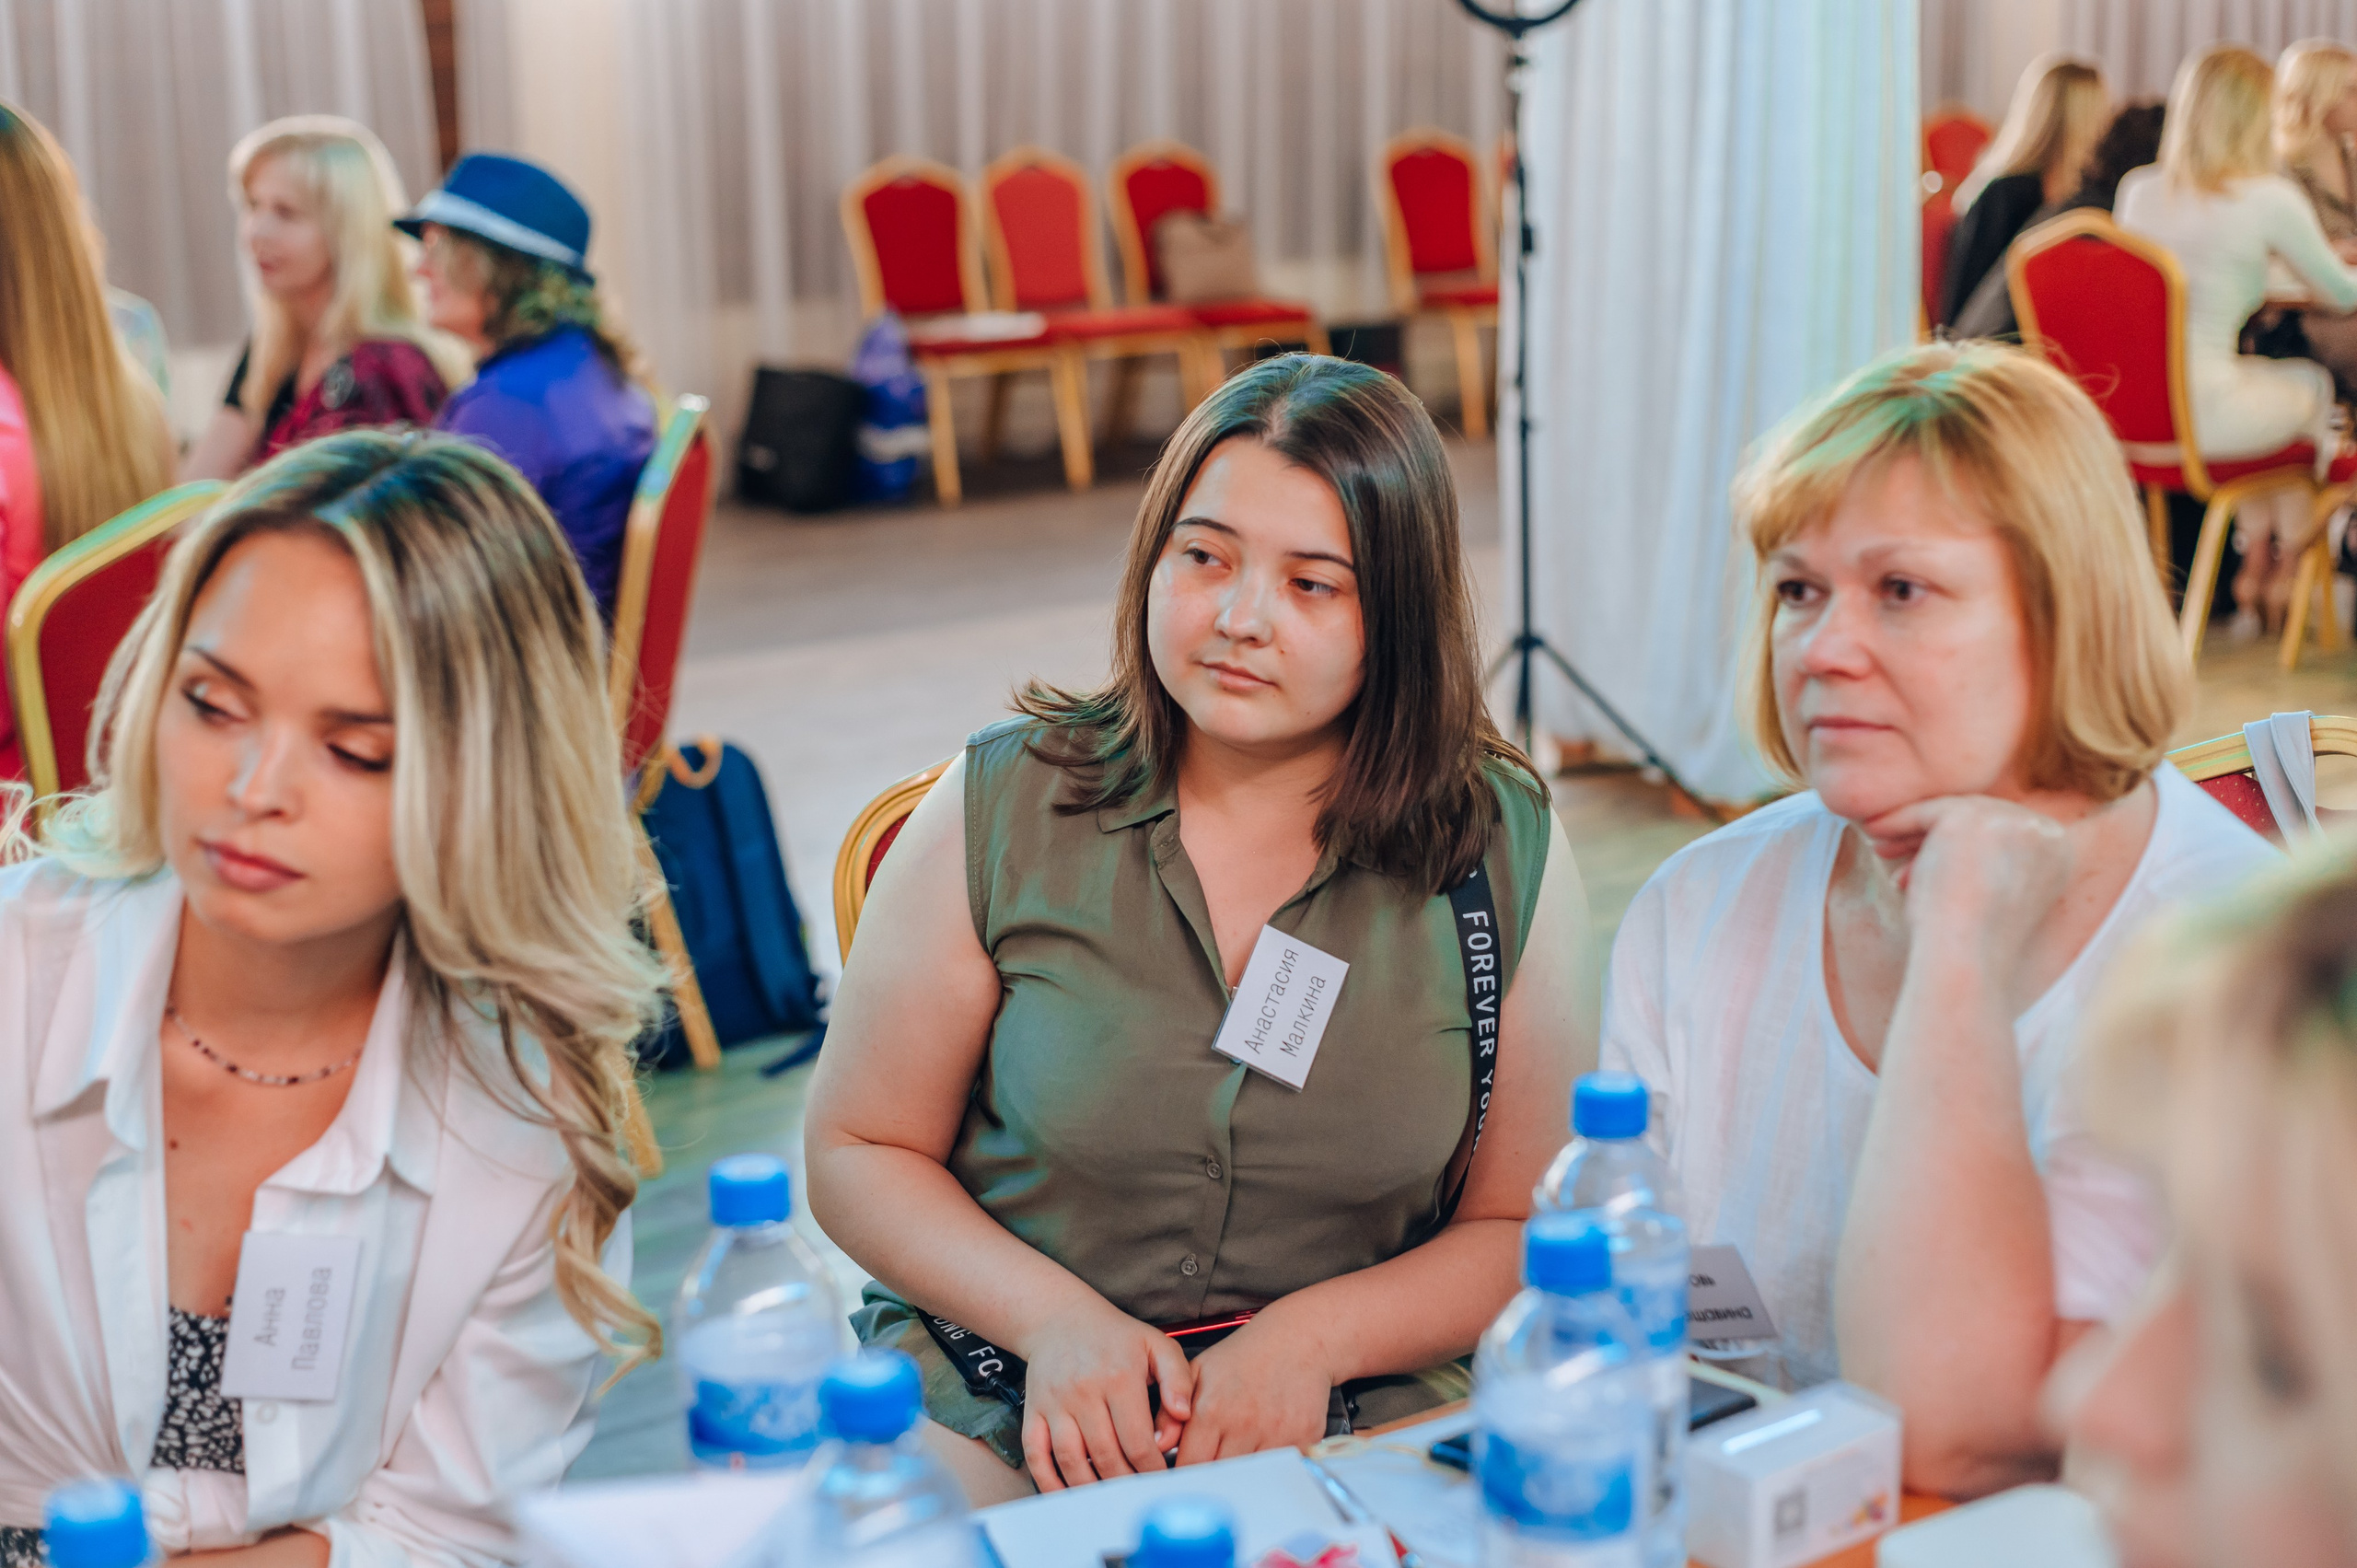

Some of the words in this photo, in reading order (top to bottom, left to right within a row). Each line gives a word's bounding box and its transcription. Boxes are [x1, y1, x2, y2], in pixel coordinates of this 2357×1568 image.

[1244, 948, 1299, 1055] Анастасия
[1279, 975, 1327, 1058] Малкина
[1462, 911, 1496, 1058] FOREVER
[253, 1287, 286, 1347] Анна
[290, 1267, 332, 1370] Павлова
